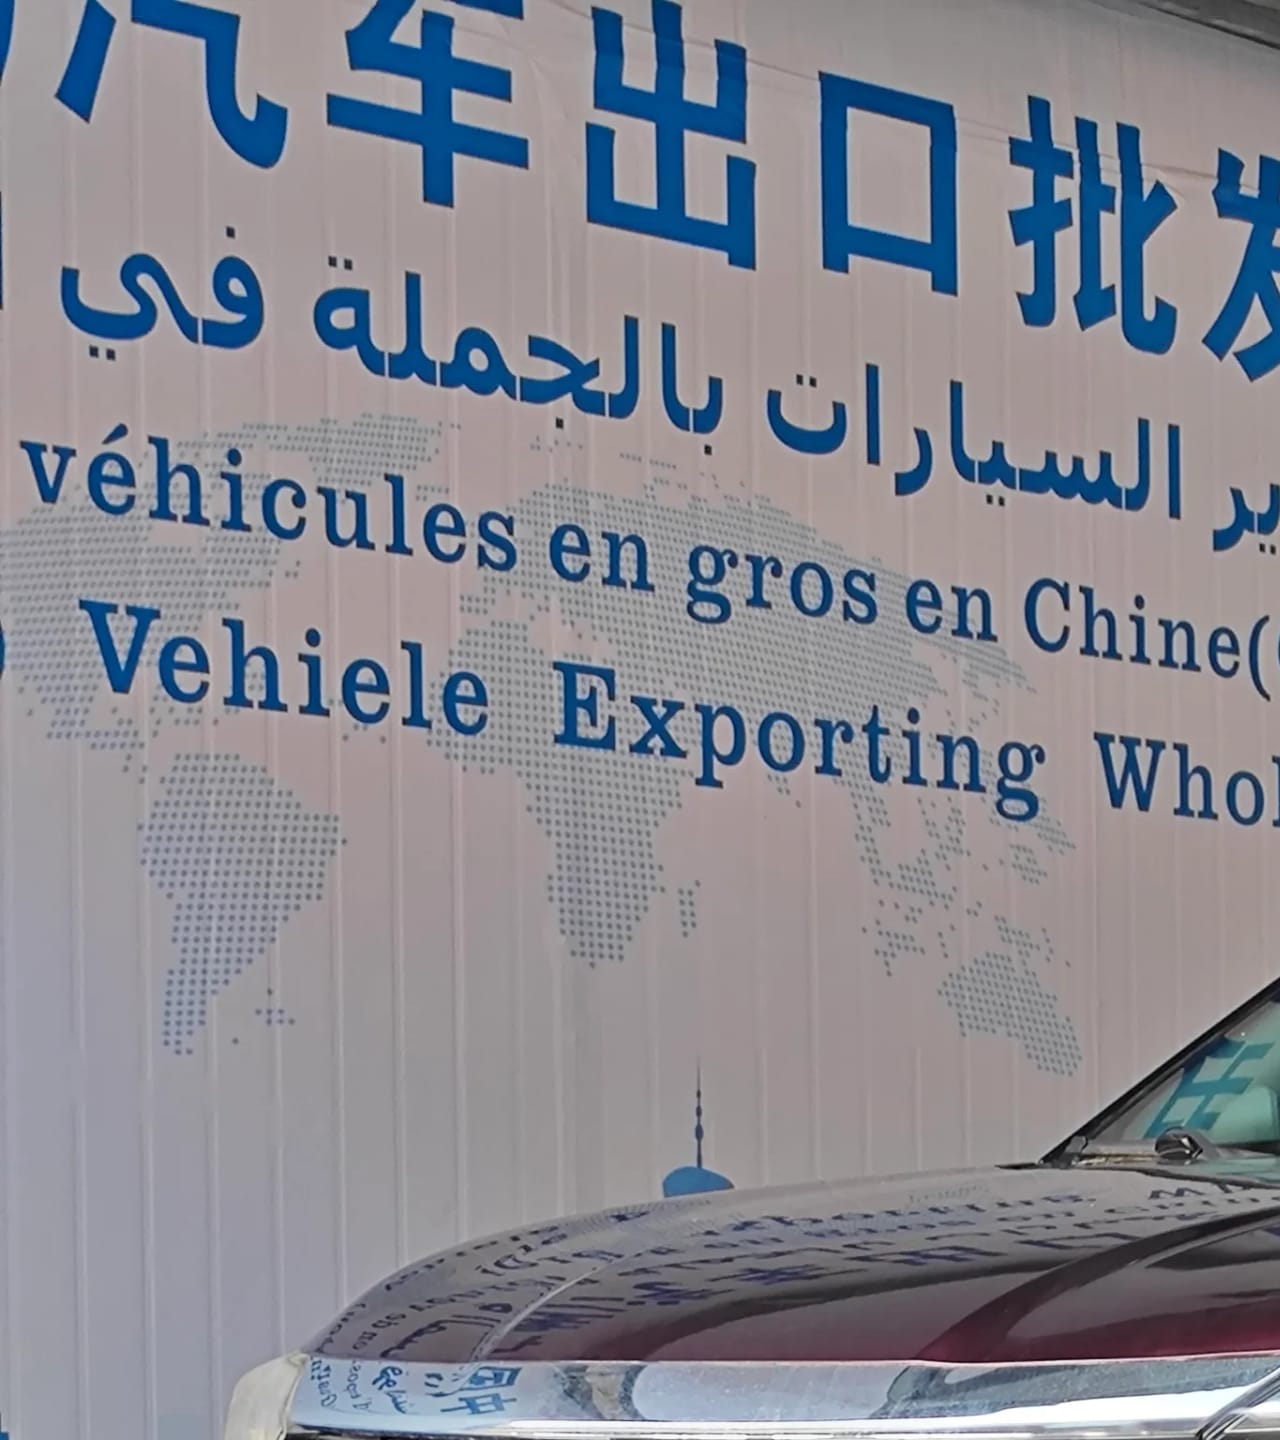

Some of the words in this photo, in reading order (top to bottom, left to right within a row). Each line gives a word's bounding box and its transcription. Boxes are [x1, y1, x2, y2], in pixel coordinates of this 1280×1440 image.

[60, 227, 264, 360] في
[313, 256, 724, 454] بالجملة
[20, 424, 518, 572] véhicules
[548, 521, 655, 592] en
[686, 543, 878, 624] gros
[905, 578, 997, 643] en
[767, 373, 1180, 518] السيارات
[78, 599, 488, 736] Vehiele
[554, 660, 1044, 822] Exporting
